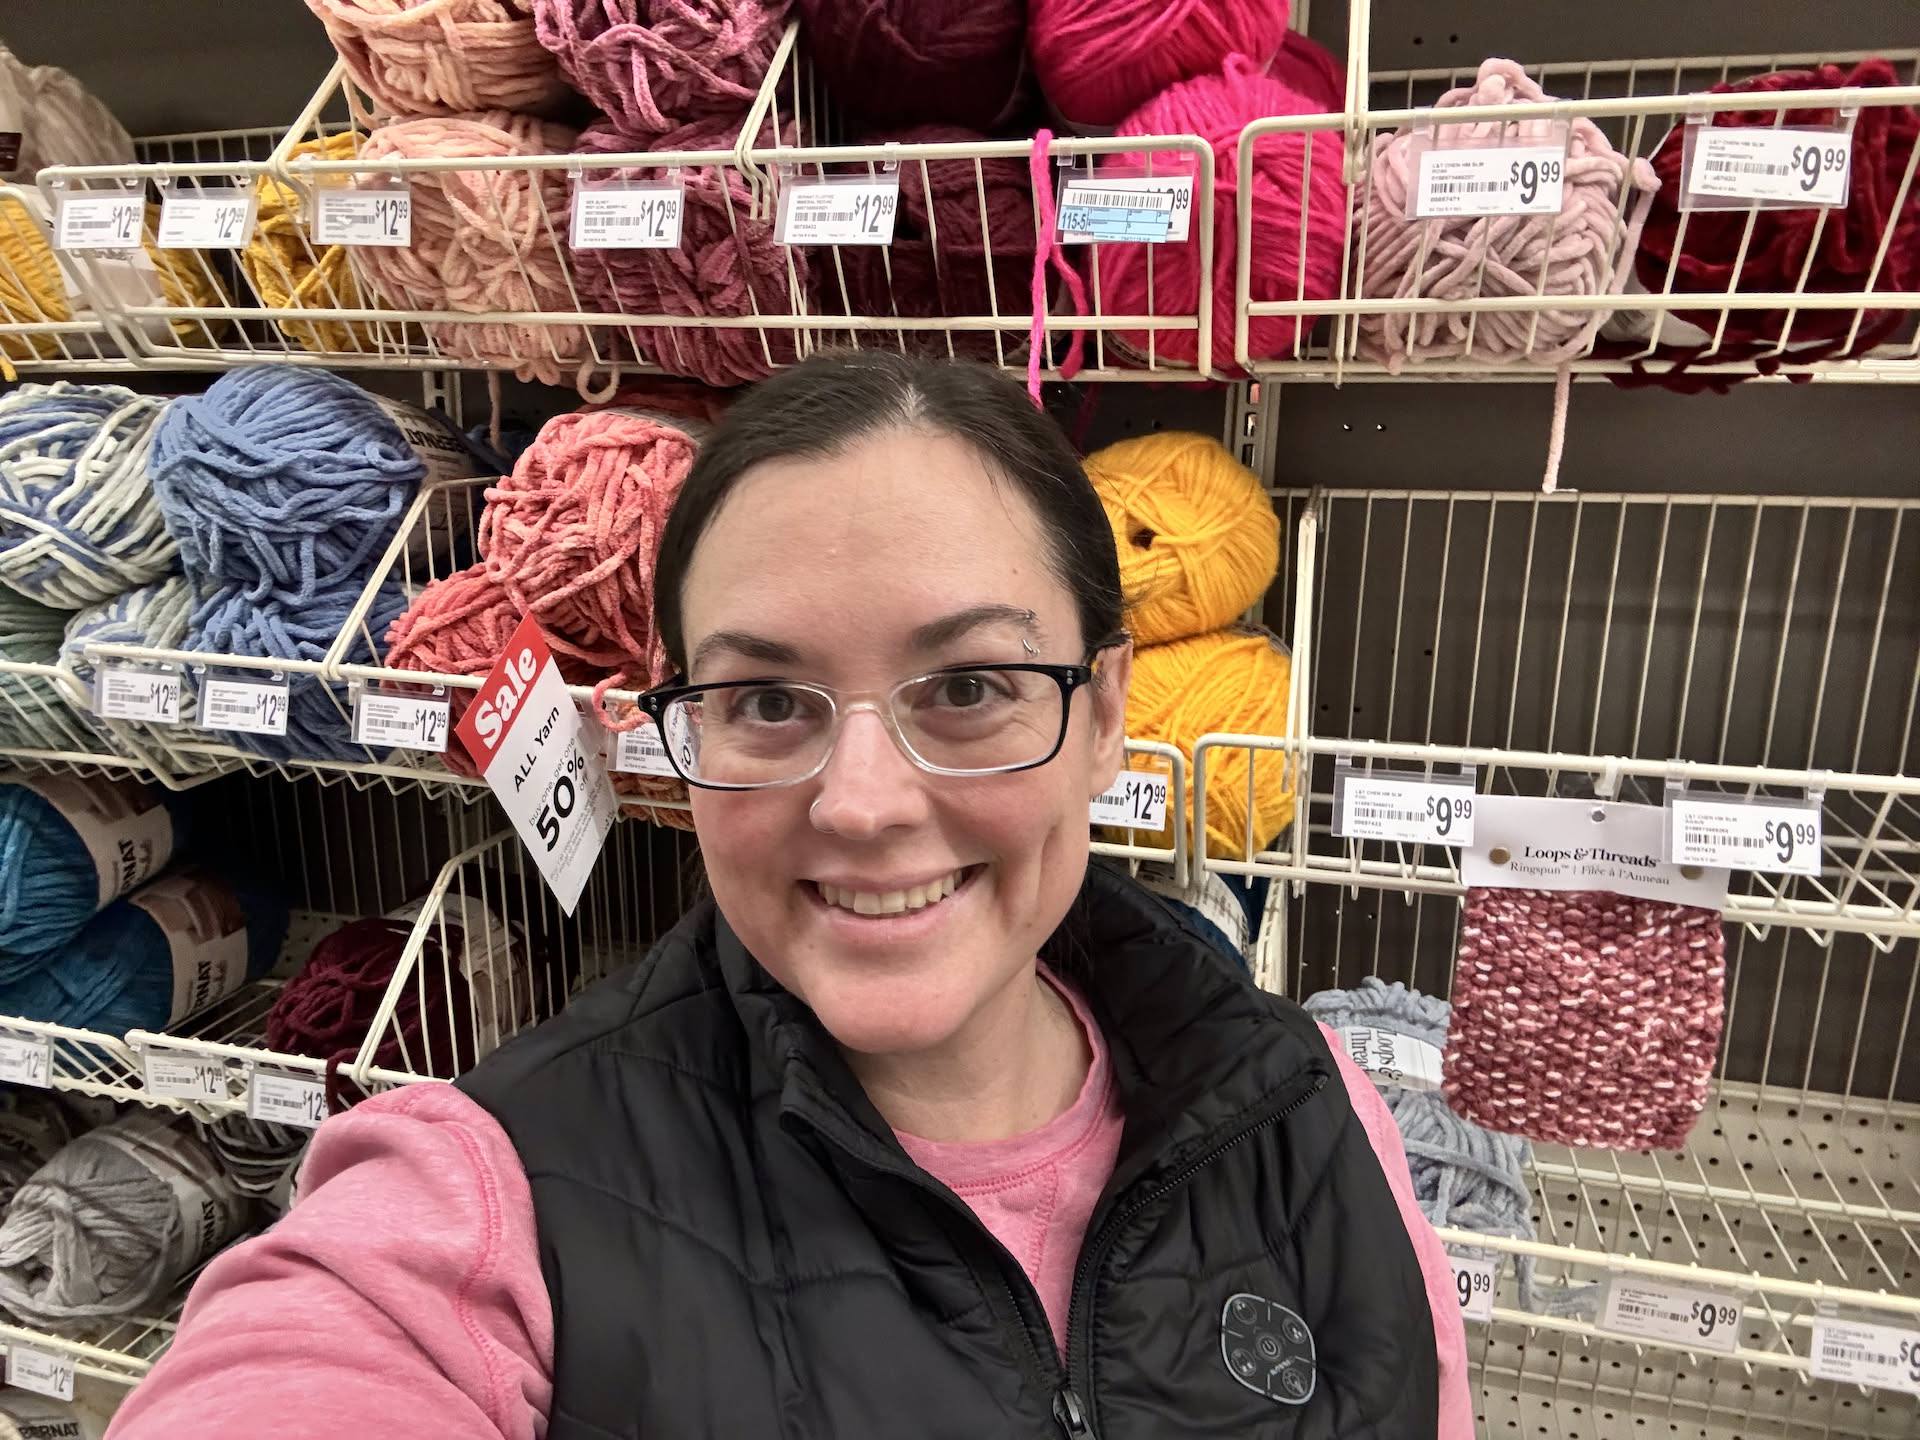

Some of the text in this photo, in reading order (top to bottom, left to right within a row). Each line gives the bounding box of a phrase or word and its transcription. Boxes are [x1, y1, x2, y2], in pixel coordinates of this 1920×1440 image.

[475, 648, 537, 750] Sale
[513, 706, 560, 792] ALL Yarn
[528, 805, 543, 827] buy
[553, 757, 566, 778] get
[564, 737, 576, 759] one
[536, 748, 585, 853] 50%
[1524, 846, 1572, 863] Loops
[1588, 848, 1658, 868] Threads
[1350, 1029, 1376, 1073] Thread
[1372, 1030, 1398, 1067] Loops
